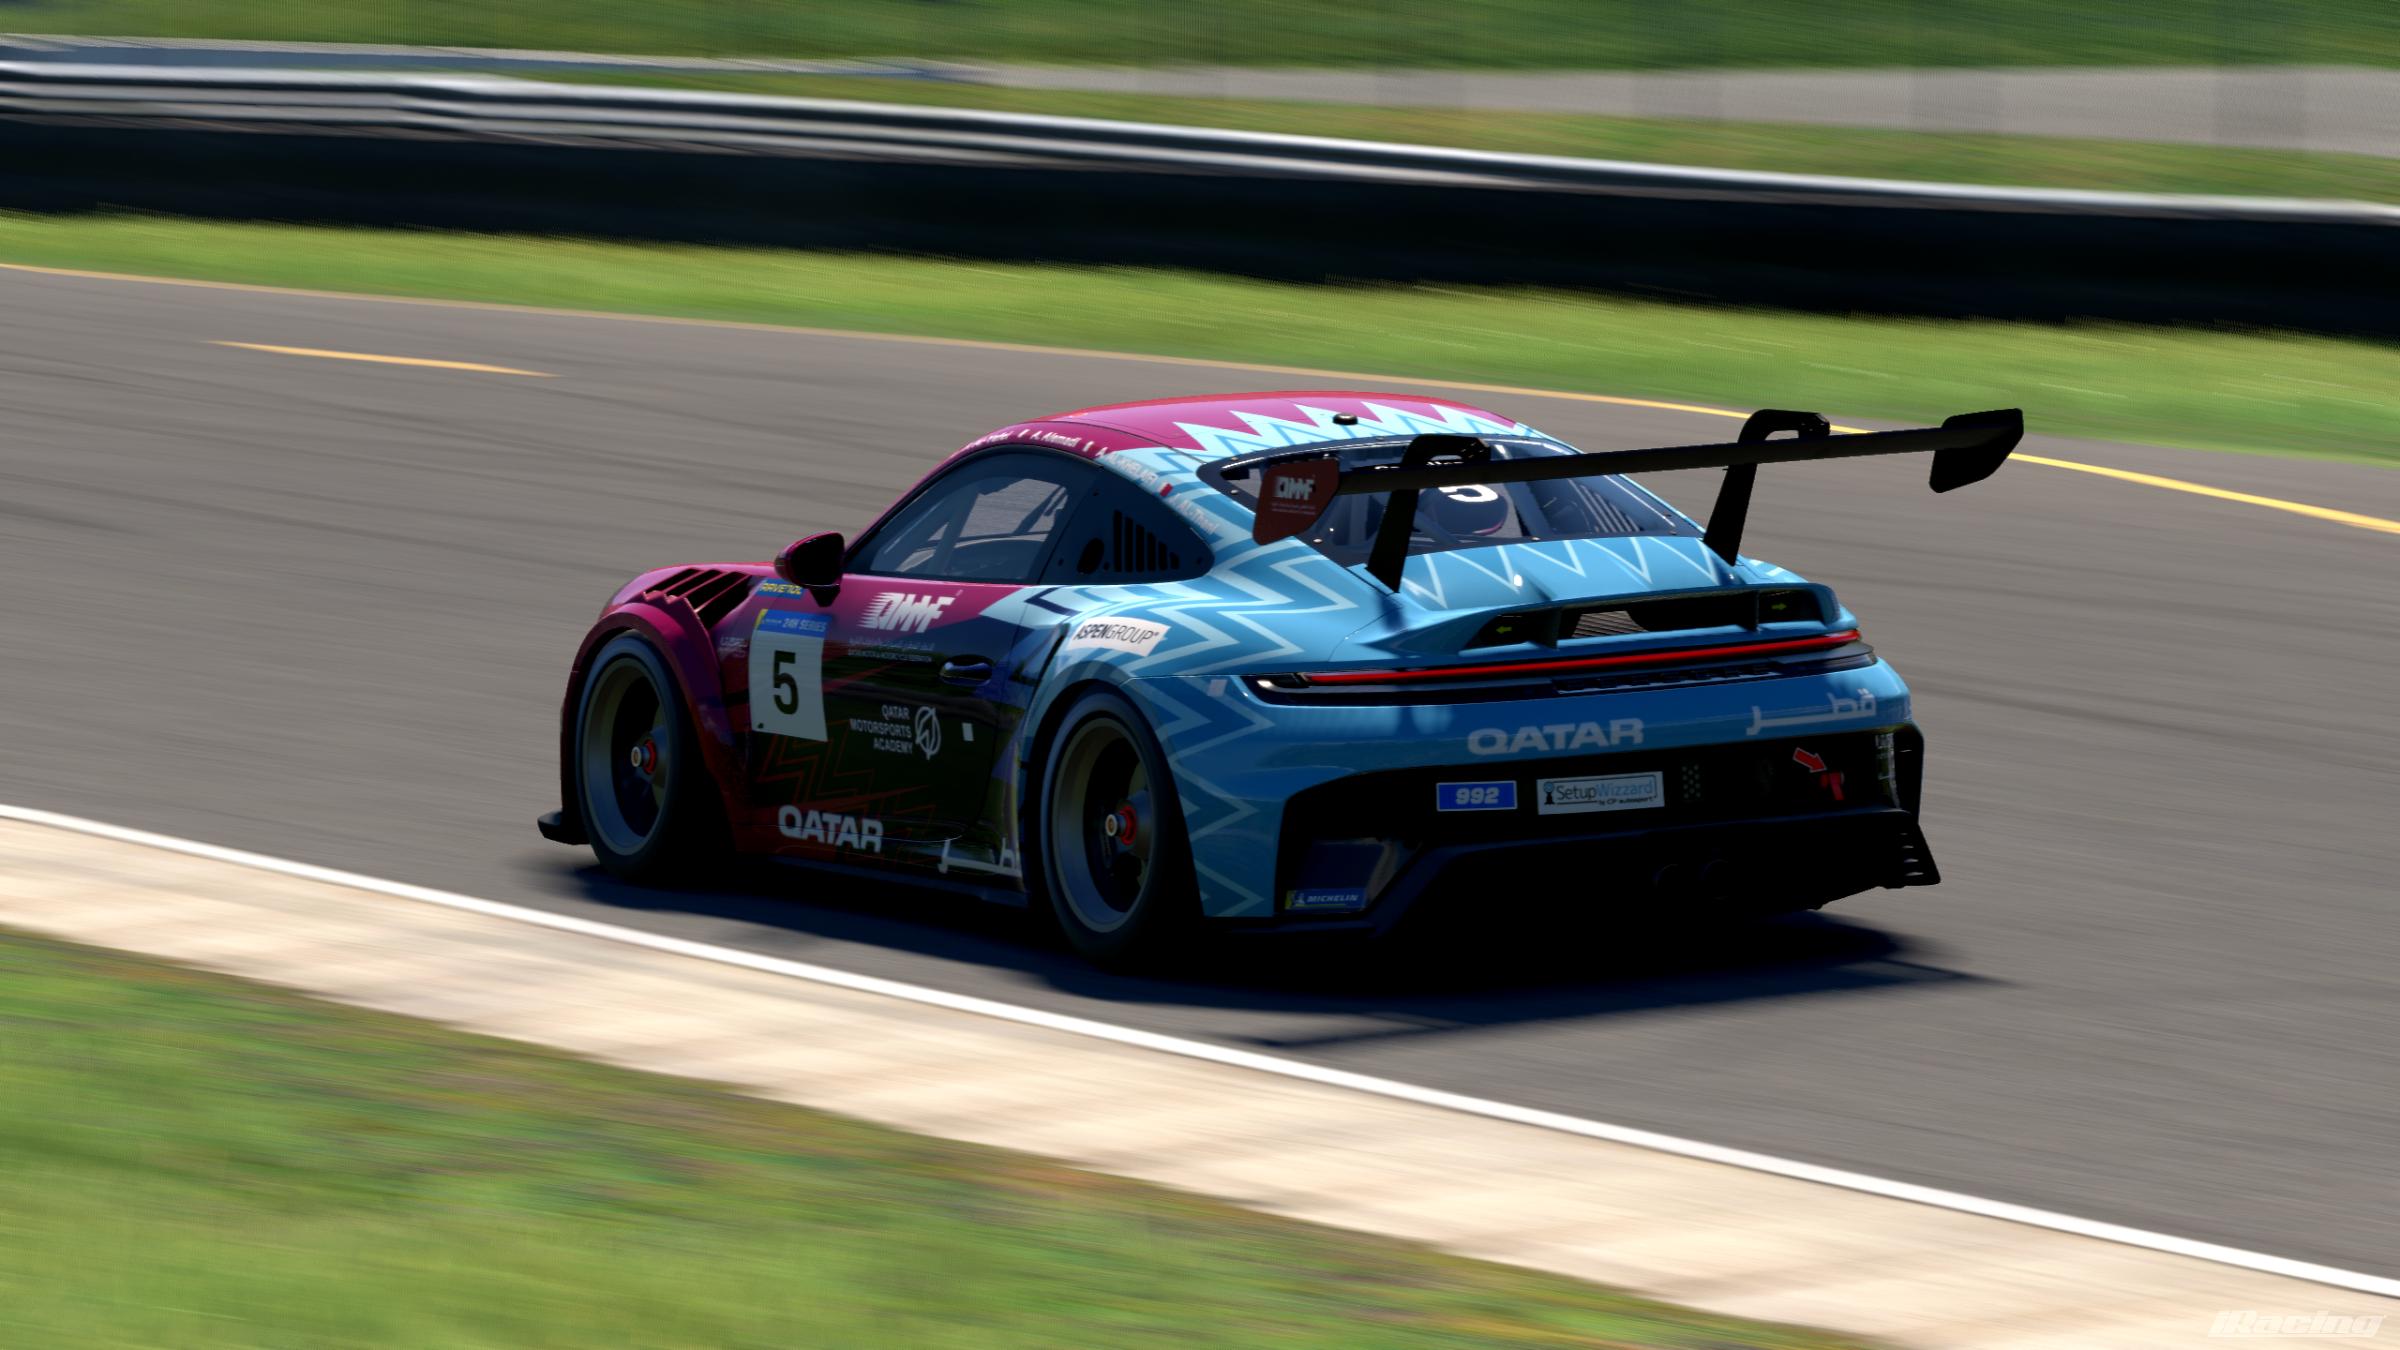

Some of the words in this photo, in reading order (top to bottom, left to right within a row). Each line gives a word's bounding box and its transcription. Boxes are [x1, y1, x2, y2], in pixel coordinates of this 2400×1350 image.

[773, 650, 799, 715] 5
[881, 704, 910, 721] QATAR
[1746, 688, 1877, 736] قطر
[849, 718, 912, 738] MOTORSPORTS
[1466, 717, 1644, 755] QATAR
[873, 737, 913, 754] ACADEMY
[1456, 787, 1500, 804] 992
[1556, 779, 1654, 800] SetupWizzard
[778, 804, 884, 853] QATAR
[1307, 894, 1359, 903] MICHELIN
